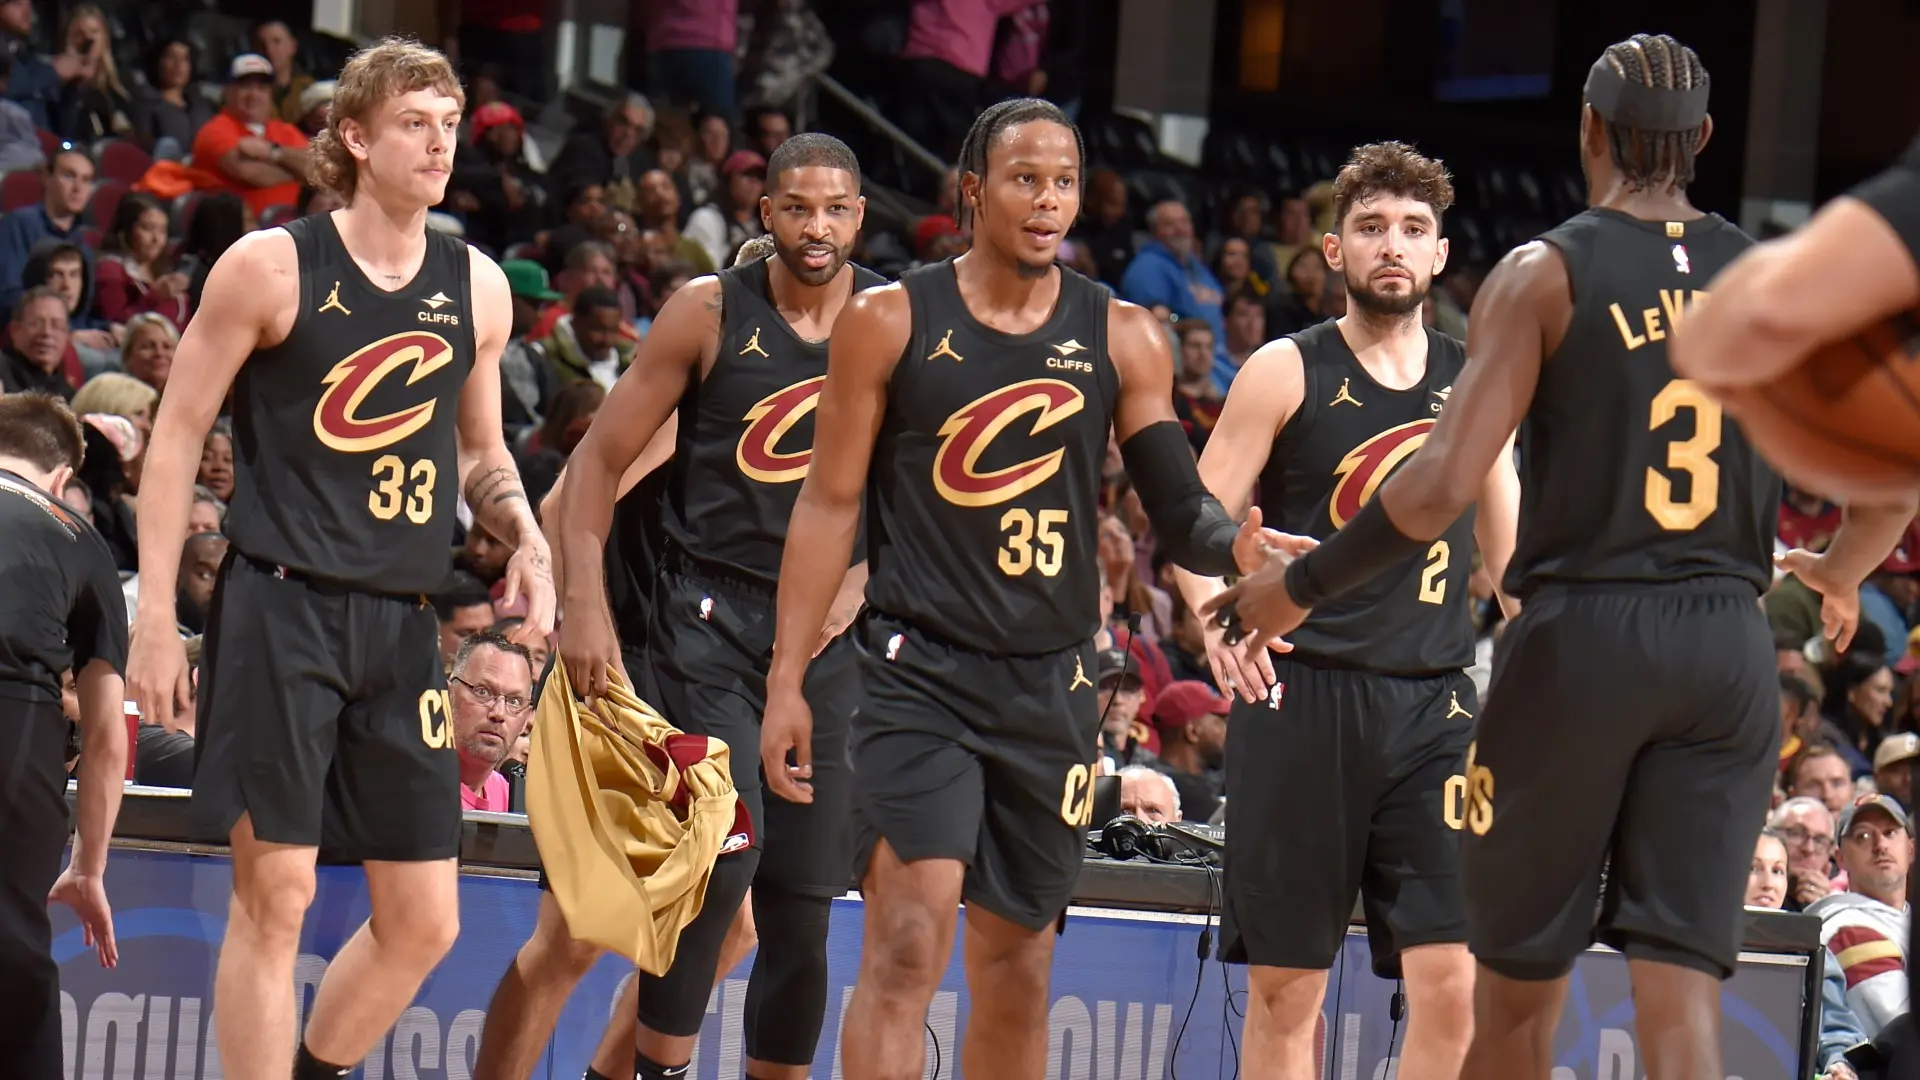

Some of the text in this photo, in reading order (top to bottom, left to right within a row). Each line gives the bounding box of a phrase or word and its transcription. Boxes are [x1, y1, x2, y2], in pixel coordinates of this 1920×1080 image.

[418, 312, 459, 326] CLIFFS
[314, 331, 454, 452] C
[1046, 357, 1093, 373] CLIFFS
[933, 378, 1085, 507] C
[1645, 378, 1723, 531] 3
[369, 455, 437, 525] 33
[998, 508, 1068, 577] 35
[1419, 540, 1450, 604] 2
